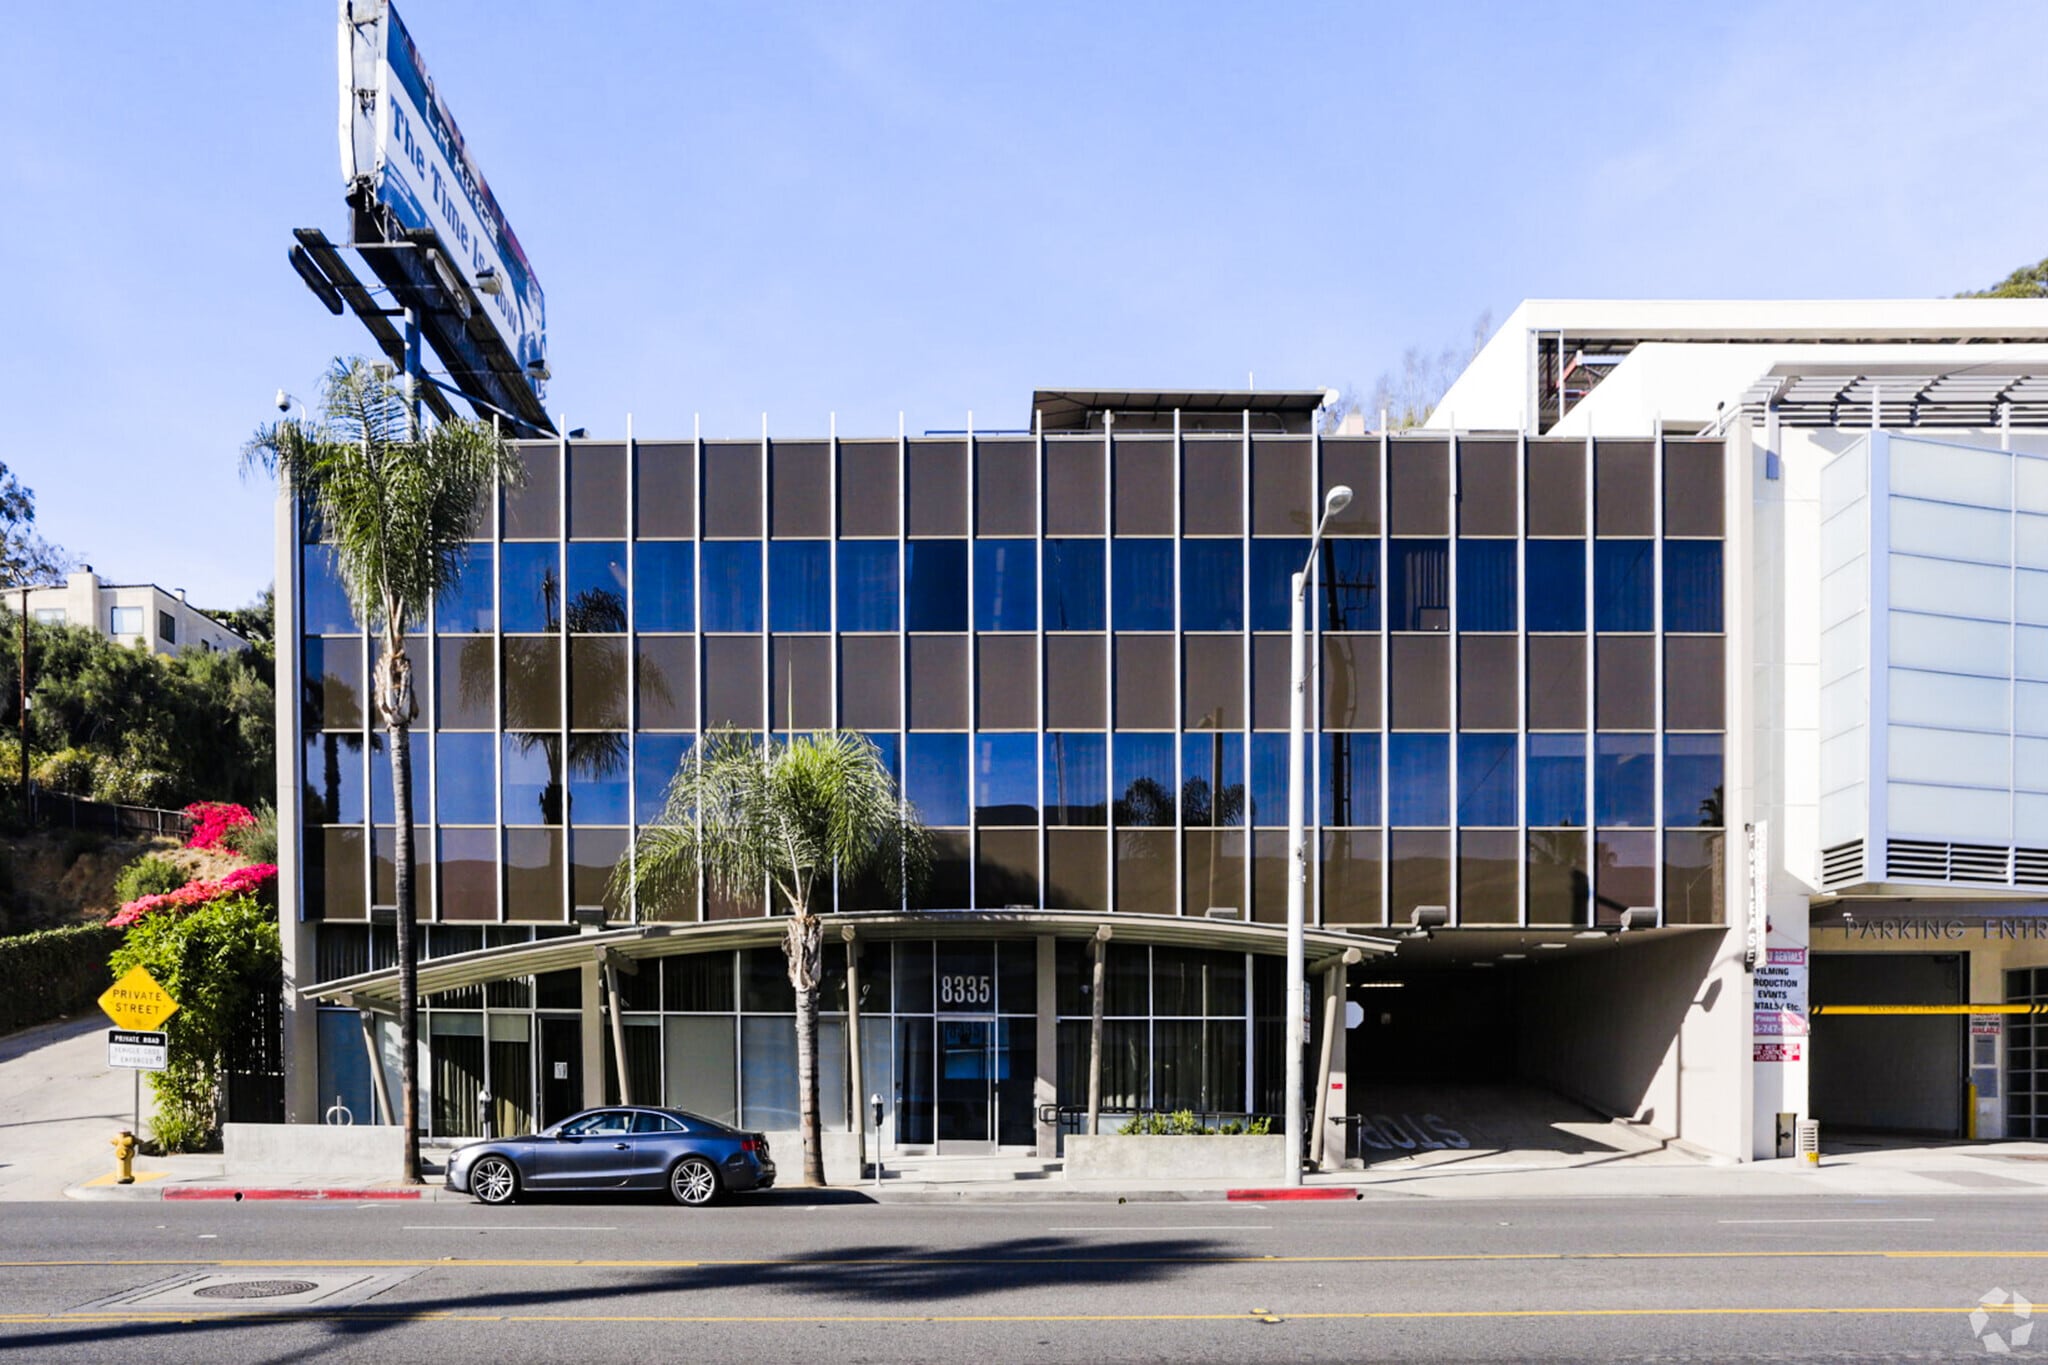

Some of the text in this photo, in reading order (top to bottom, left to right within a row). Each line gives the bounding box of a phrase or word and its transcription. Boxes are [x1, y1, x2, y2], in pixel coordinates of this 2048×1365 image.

[390, 92, 425, 181] The
[431, 160, 468, 254] Time
[1845, 919, 1967, 940] PARKING
[113, 989, 162, 1001] PRIVATE
[942, 976, 990, 1003] 8335
[115, 1003, 160, 1015] STREET
